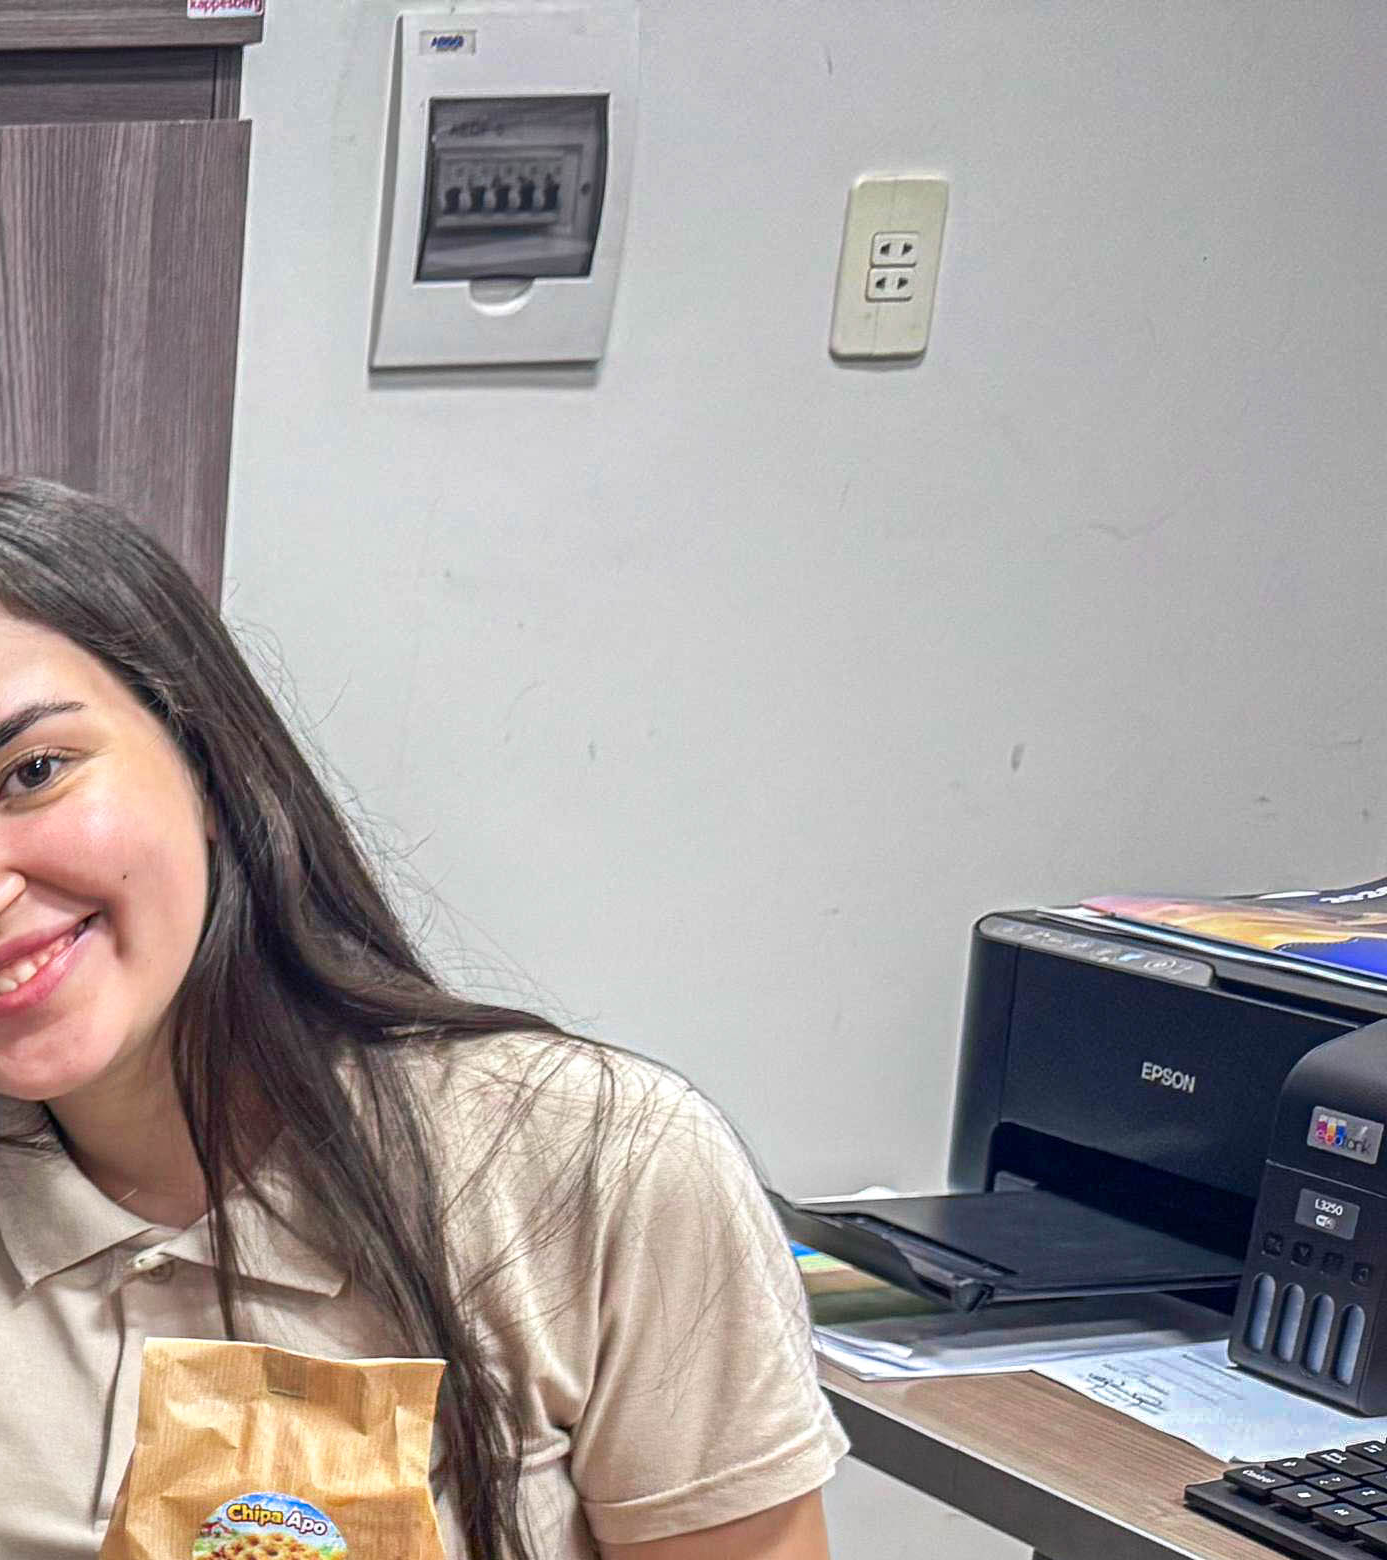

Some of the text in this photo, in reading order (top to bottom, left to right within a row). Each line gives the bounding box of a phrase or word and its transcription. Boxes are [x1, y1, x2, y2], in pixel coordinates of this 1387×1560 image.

[1141, 1061, 1195, 1093] EPSON
[227, 1503, 328, 1536] Chipa Apo
